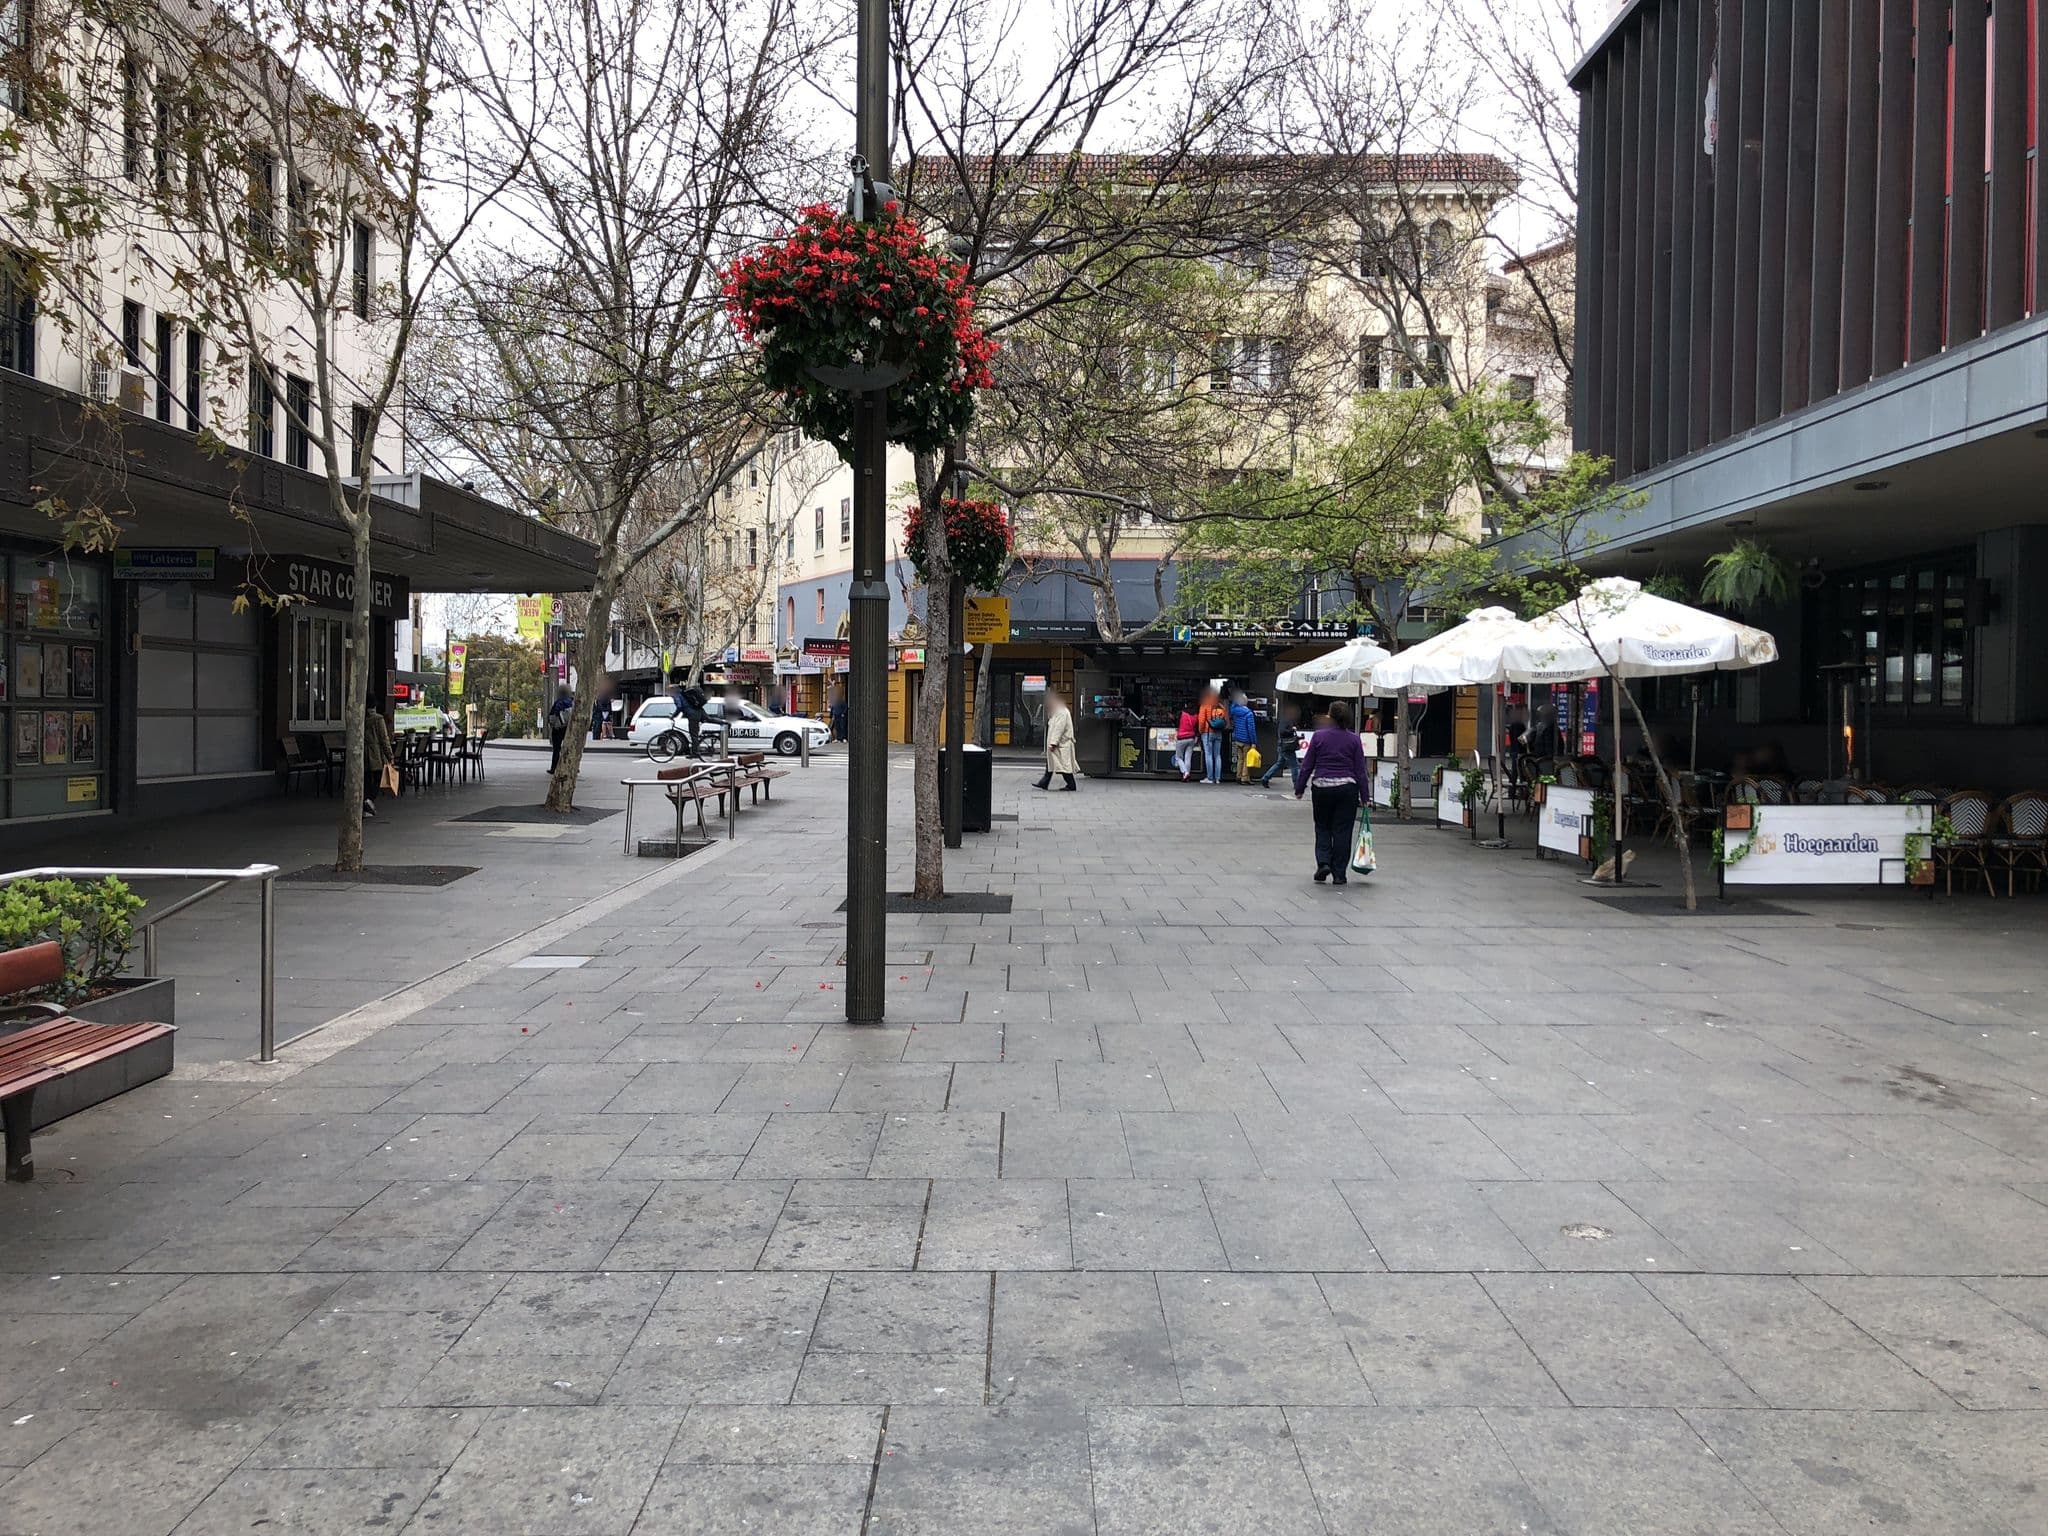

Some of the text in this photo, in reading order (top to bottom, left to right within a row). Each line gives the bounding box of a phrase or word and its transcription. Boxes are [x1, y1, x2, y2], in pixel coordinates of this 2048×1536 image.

[150, 552, 194, 565] Lotteries
[288, 563, 393, 608] STAR COER
[1191, 620, 1349, 630] APEX CAFE
[1011, 628, 1020, 636] Rd
[1642, 644, 1712, 663] Hoegaarden
[740, 728, 760, 737] CABS
[1783, 832, 1879, 856] Hoegaarden
